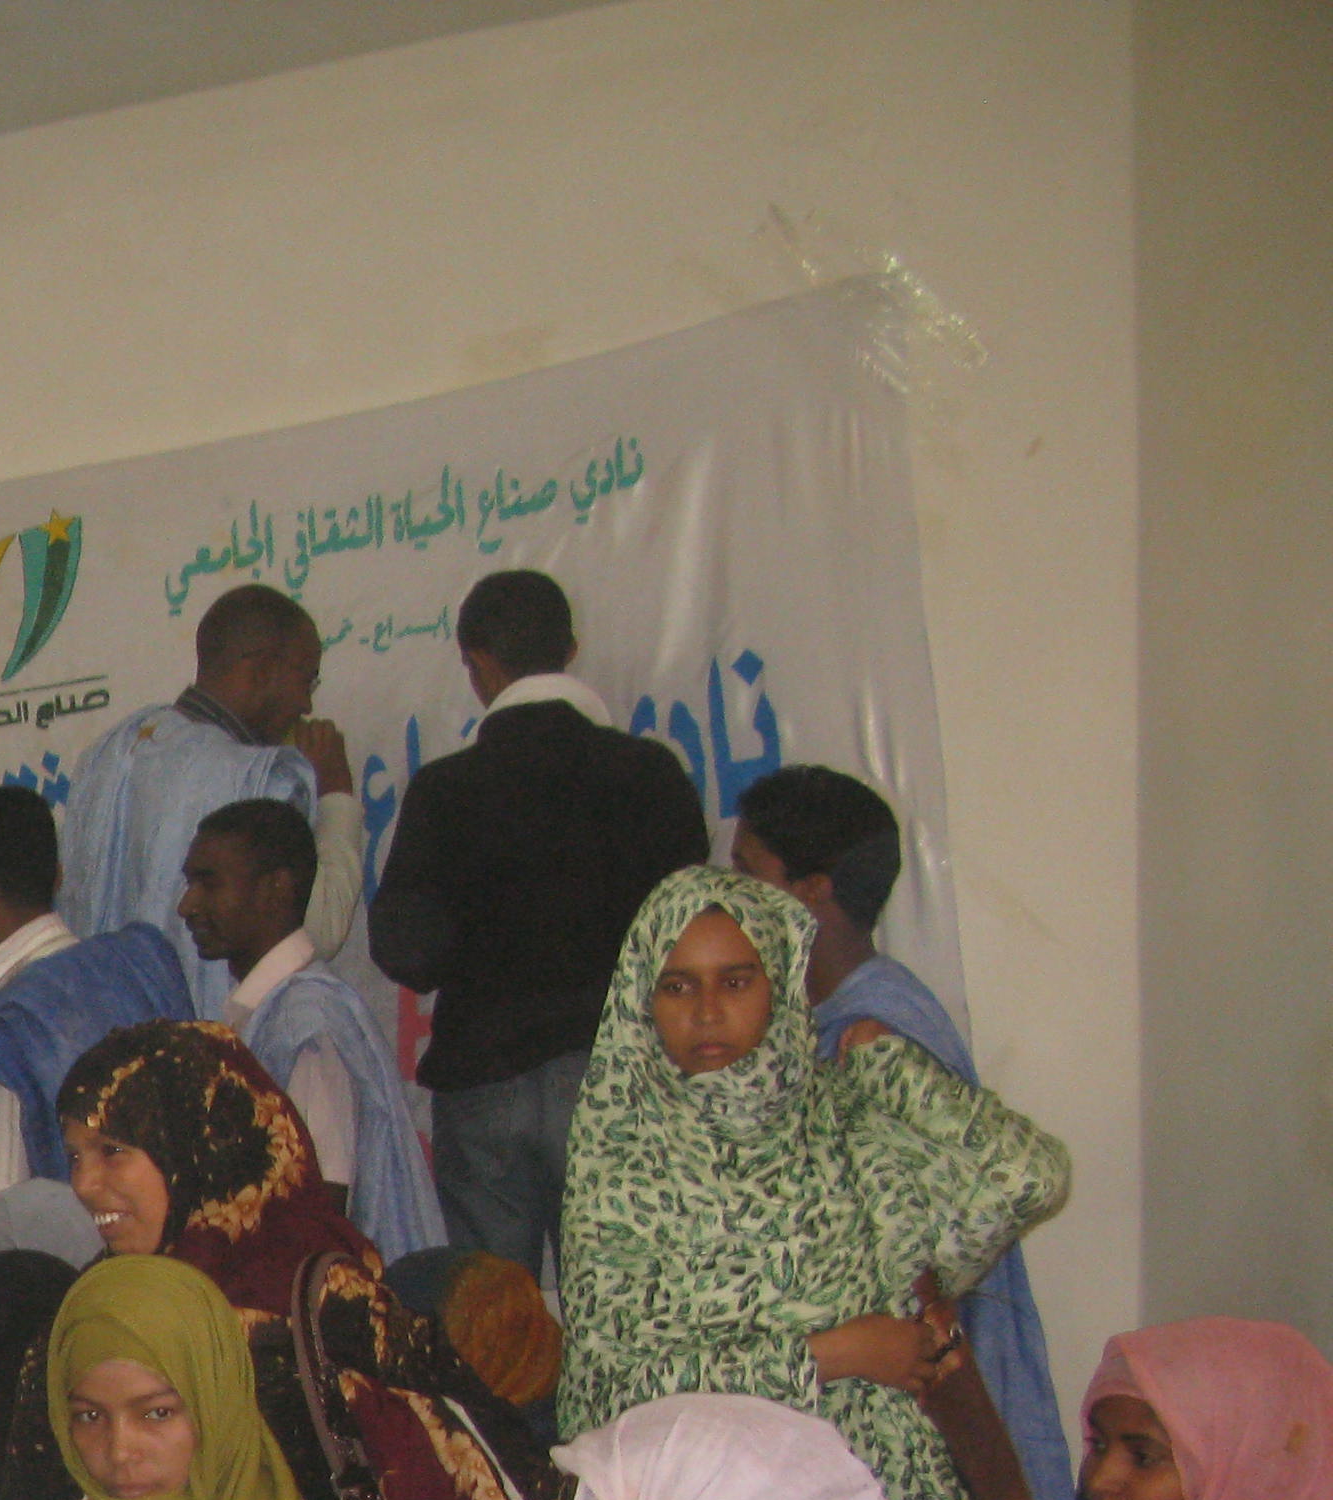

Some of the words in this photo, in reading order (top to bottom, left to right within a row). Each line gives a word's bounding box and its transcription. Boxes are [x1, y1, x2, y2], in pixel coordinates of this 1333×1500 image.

[390, 463, 465, 551] الحياة
[477, 467, 558, 554] صناع
[570, 436, 644, 524] نادي
[165, 498, 275, 617] الجامعي
[284, 493, 385, 602] الثقافي
[35, 688, 110, 729] صناع
